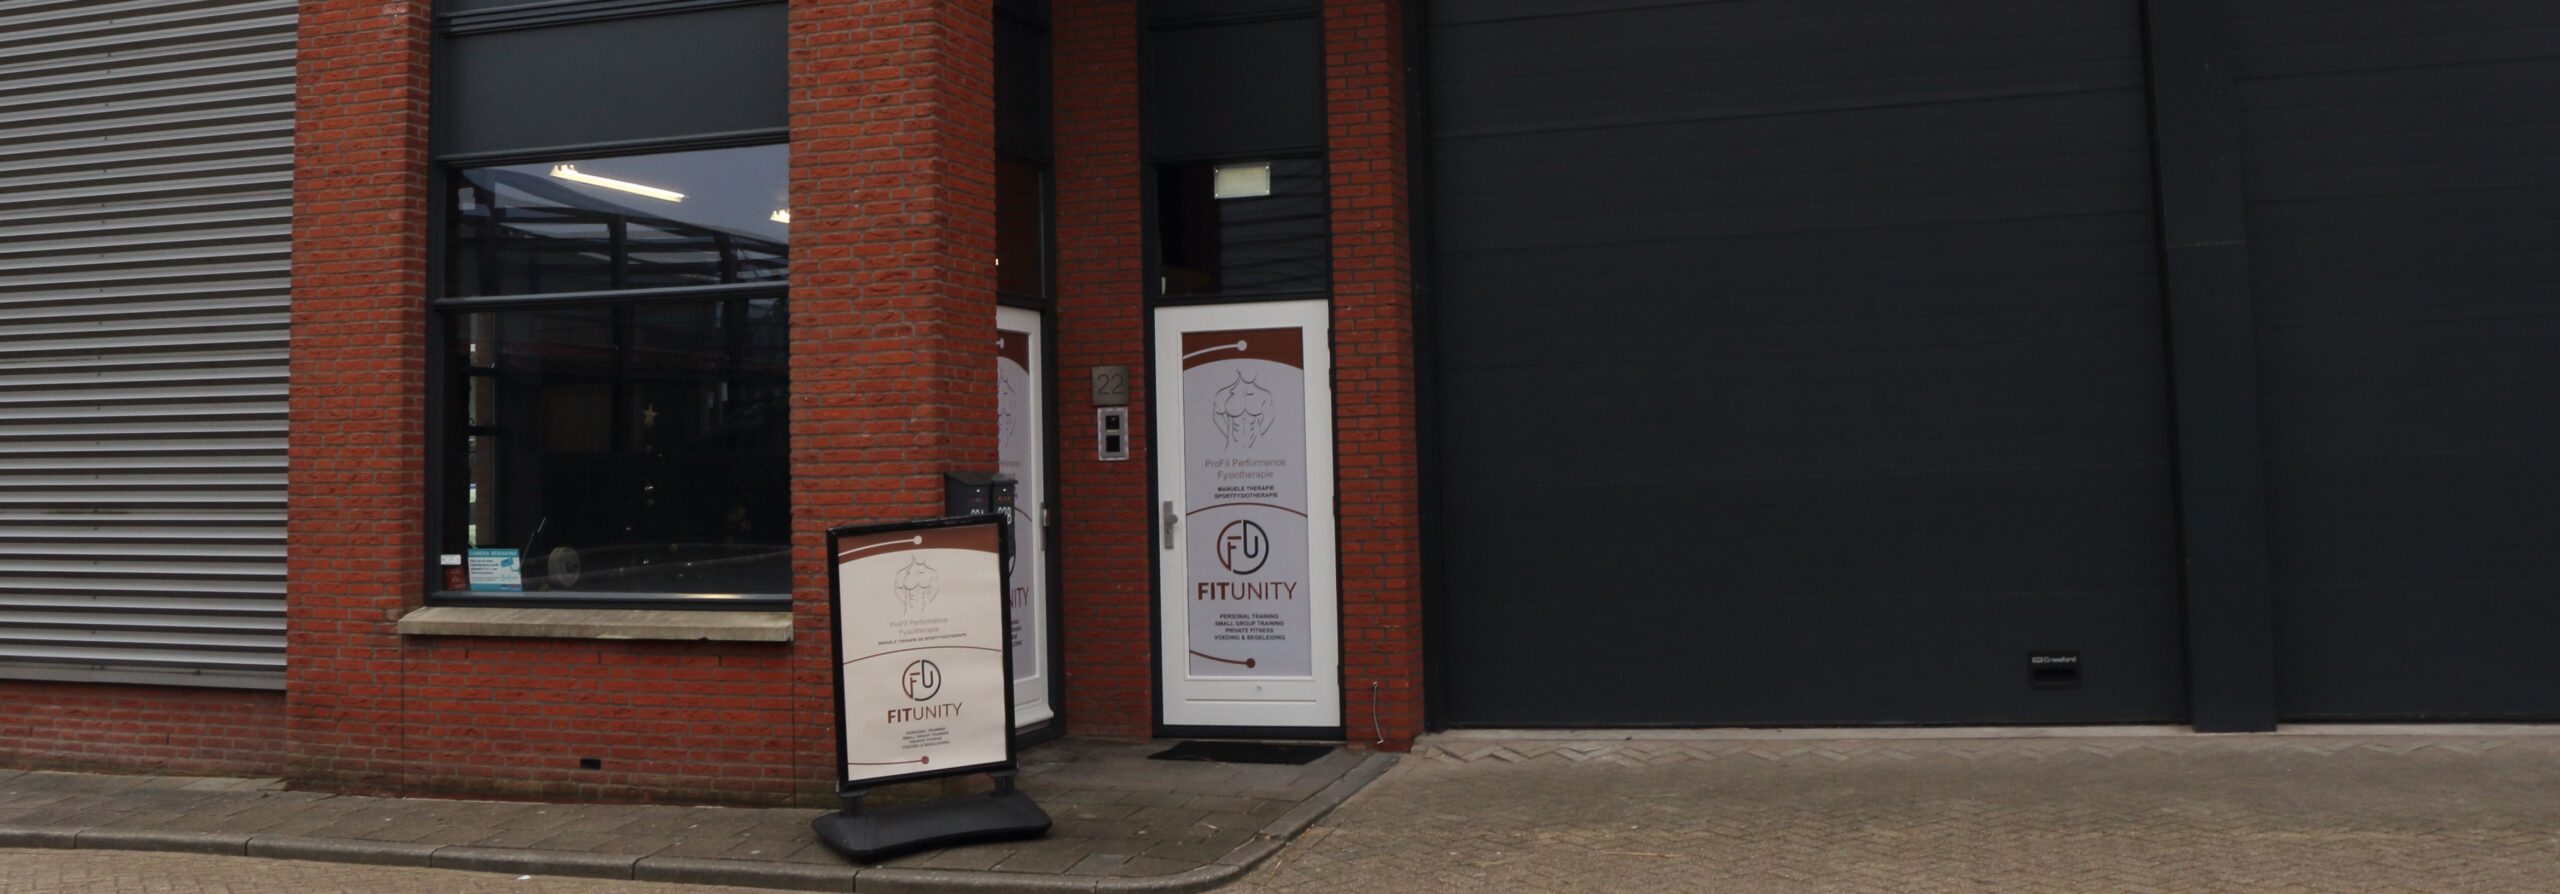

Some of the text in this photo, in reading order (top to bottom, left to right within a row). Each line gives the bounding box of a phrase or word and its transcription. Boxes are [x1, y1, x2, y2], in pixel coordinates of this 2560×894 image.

[1097, 373, 1124, 395] 22
[1205, 458, 1286, 468] ProFit Performance
[1217, 470, 1274, 482] Fysiotherapie
[1197, 581, 1297, 601] FITUNITY
[887, 702, 962, 724] FITUNITY
